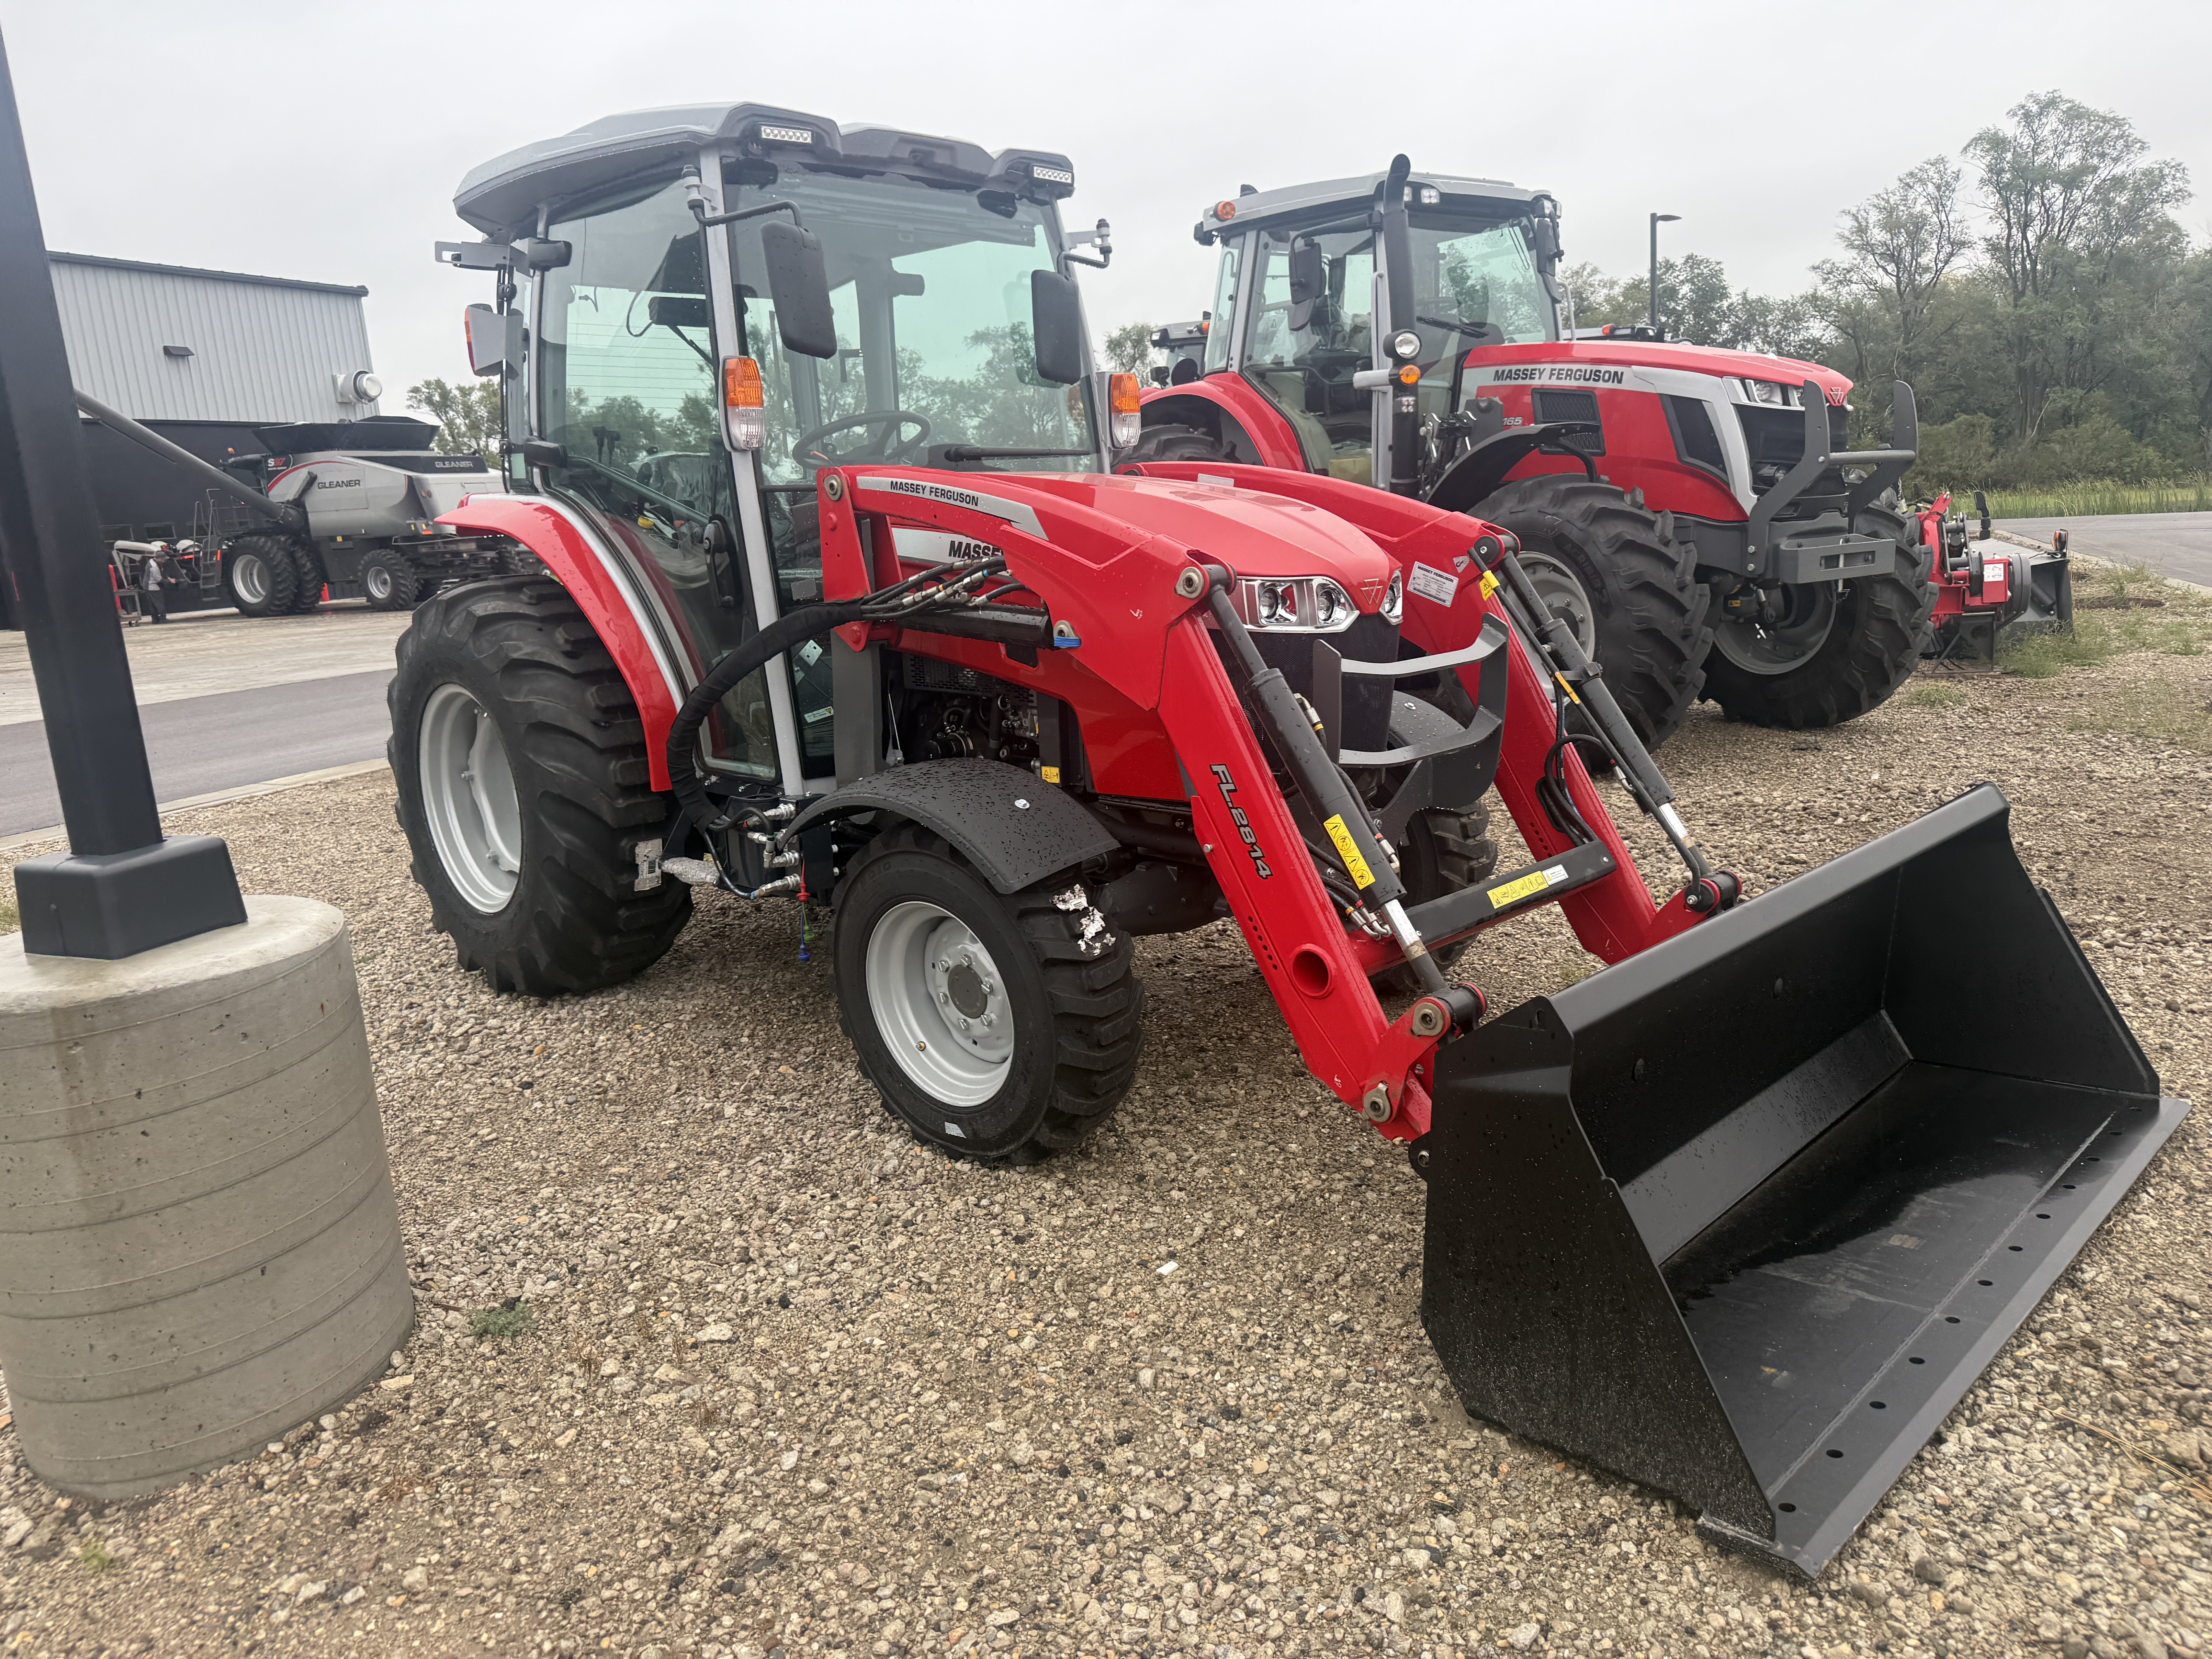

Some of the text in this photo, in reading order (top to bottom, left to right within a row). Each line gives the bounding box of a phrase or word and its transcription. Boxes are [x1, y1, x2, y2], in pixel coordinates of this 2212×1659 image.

[1493, 368, 1624, 384] MASSEY FERGUSON
[318, 479, 361, 489] GLEANER
[891, 481, 979, 507] MASSEY FERGUSON
[948, 540, 1004, 558] MASSE
